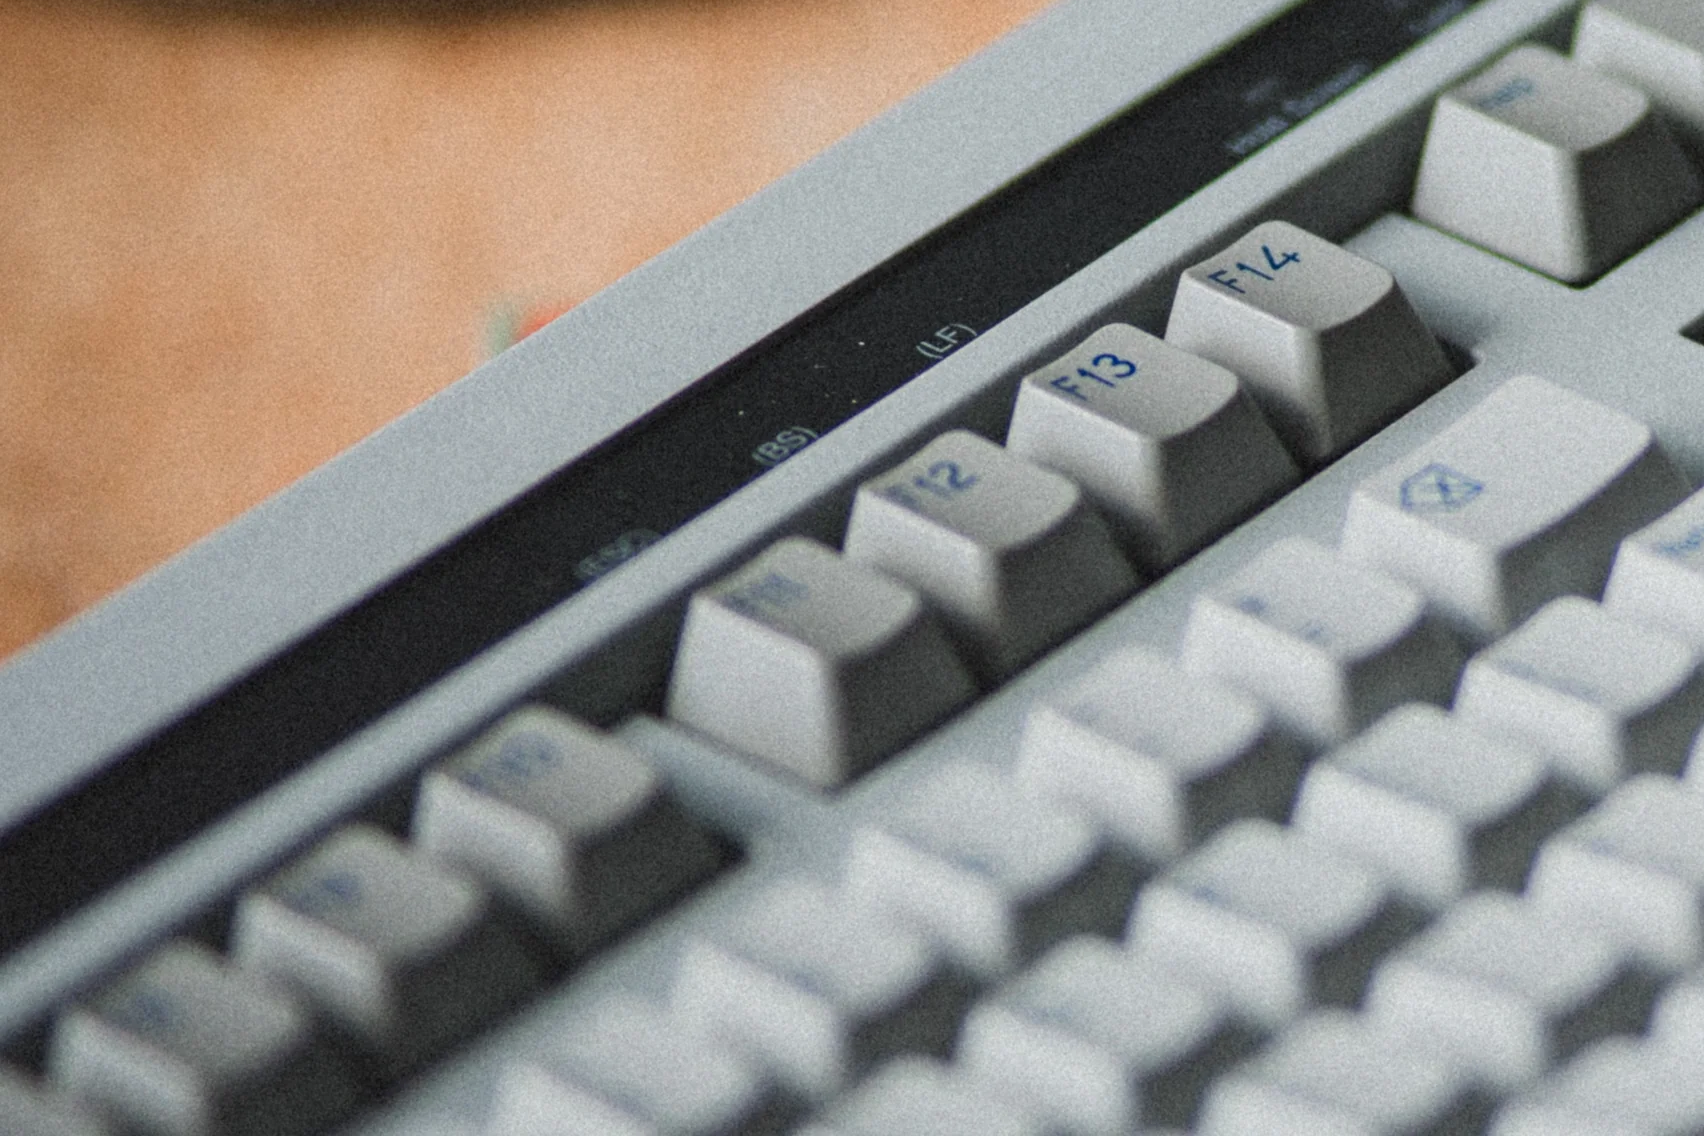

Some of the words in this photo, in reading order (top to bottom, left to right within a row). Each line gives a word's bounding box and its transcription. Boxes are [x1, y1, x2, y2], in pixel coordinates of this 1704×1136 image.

[1207, 241, 1302, 295] F14
[915, 322, 979, 360] (LF)
[1050, 352, 1138, 402] F13
[750, 425, 820, 467] (BS)
[884, 460, 981, 512] F12
